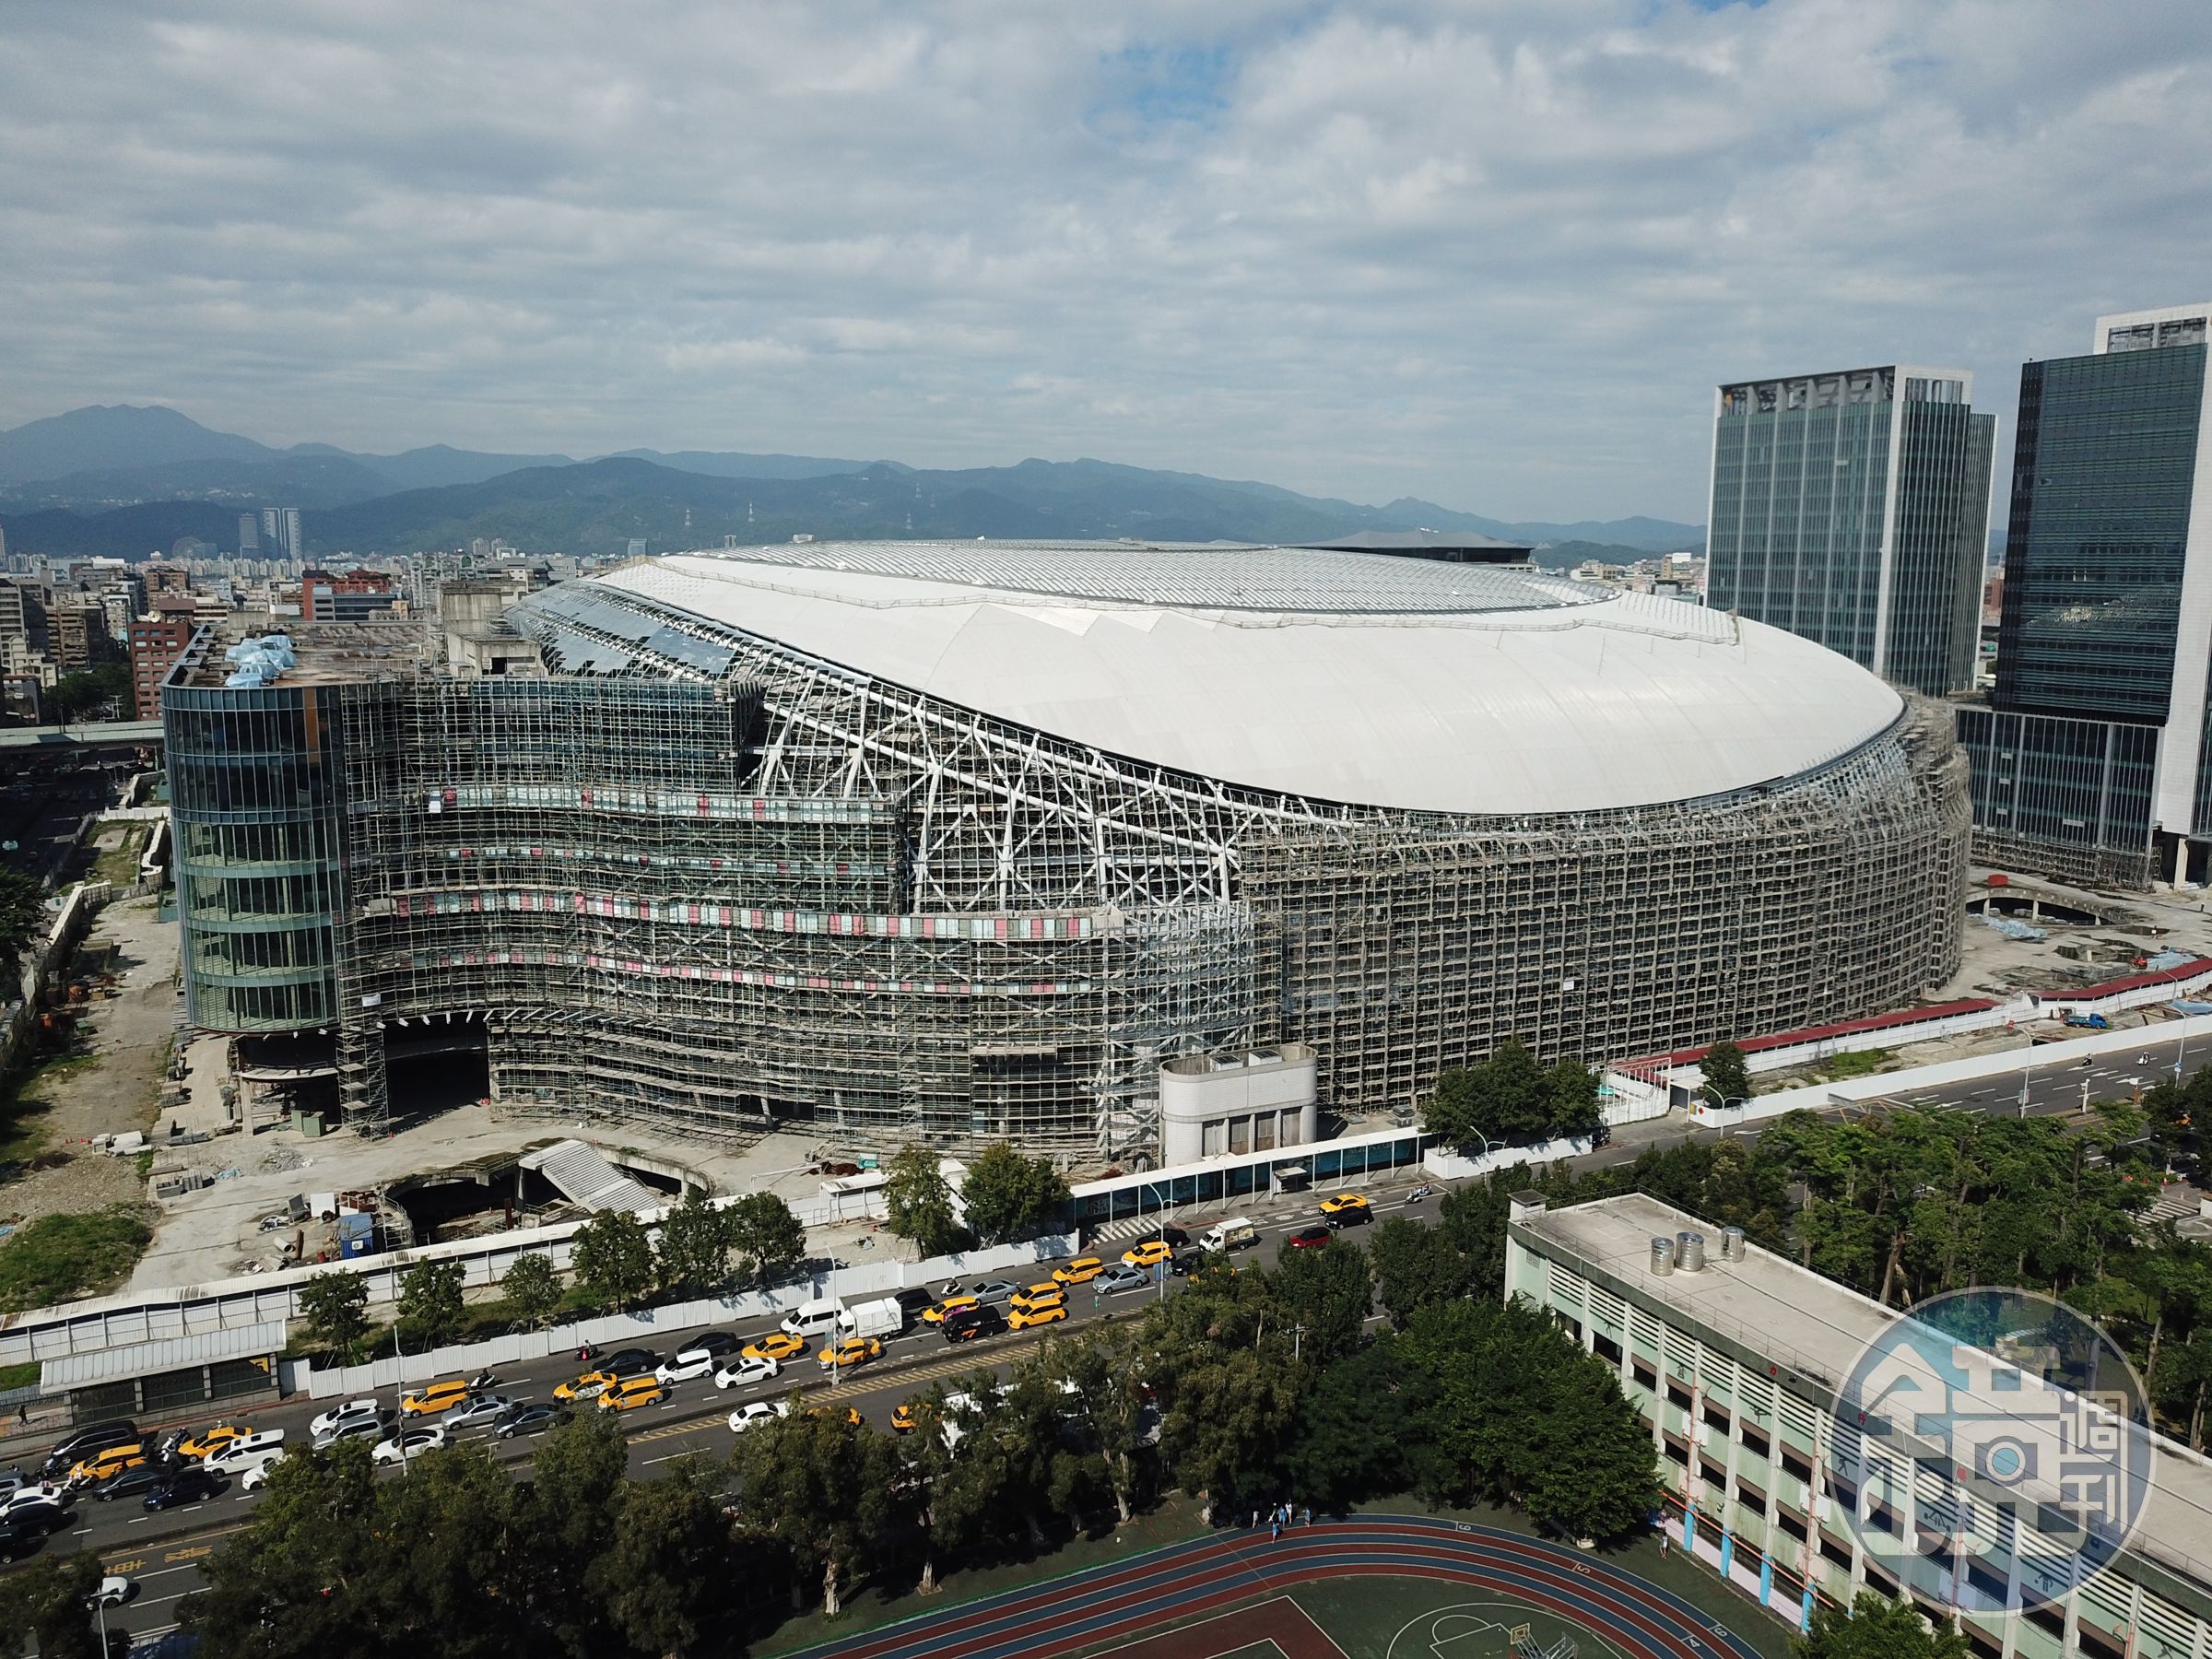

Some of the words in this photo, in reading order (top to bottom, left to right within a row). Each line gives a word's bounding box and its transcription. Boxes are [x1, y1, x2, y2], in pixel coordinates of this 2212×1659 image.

[1576, 1565, 1591, 1574] 5
[1713, 1627, 1728, 1638] 6
[1688, 1638, 1700, 1648] 4
